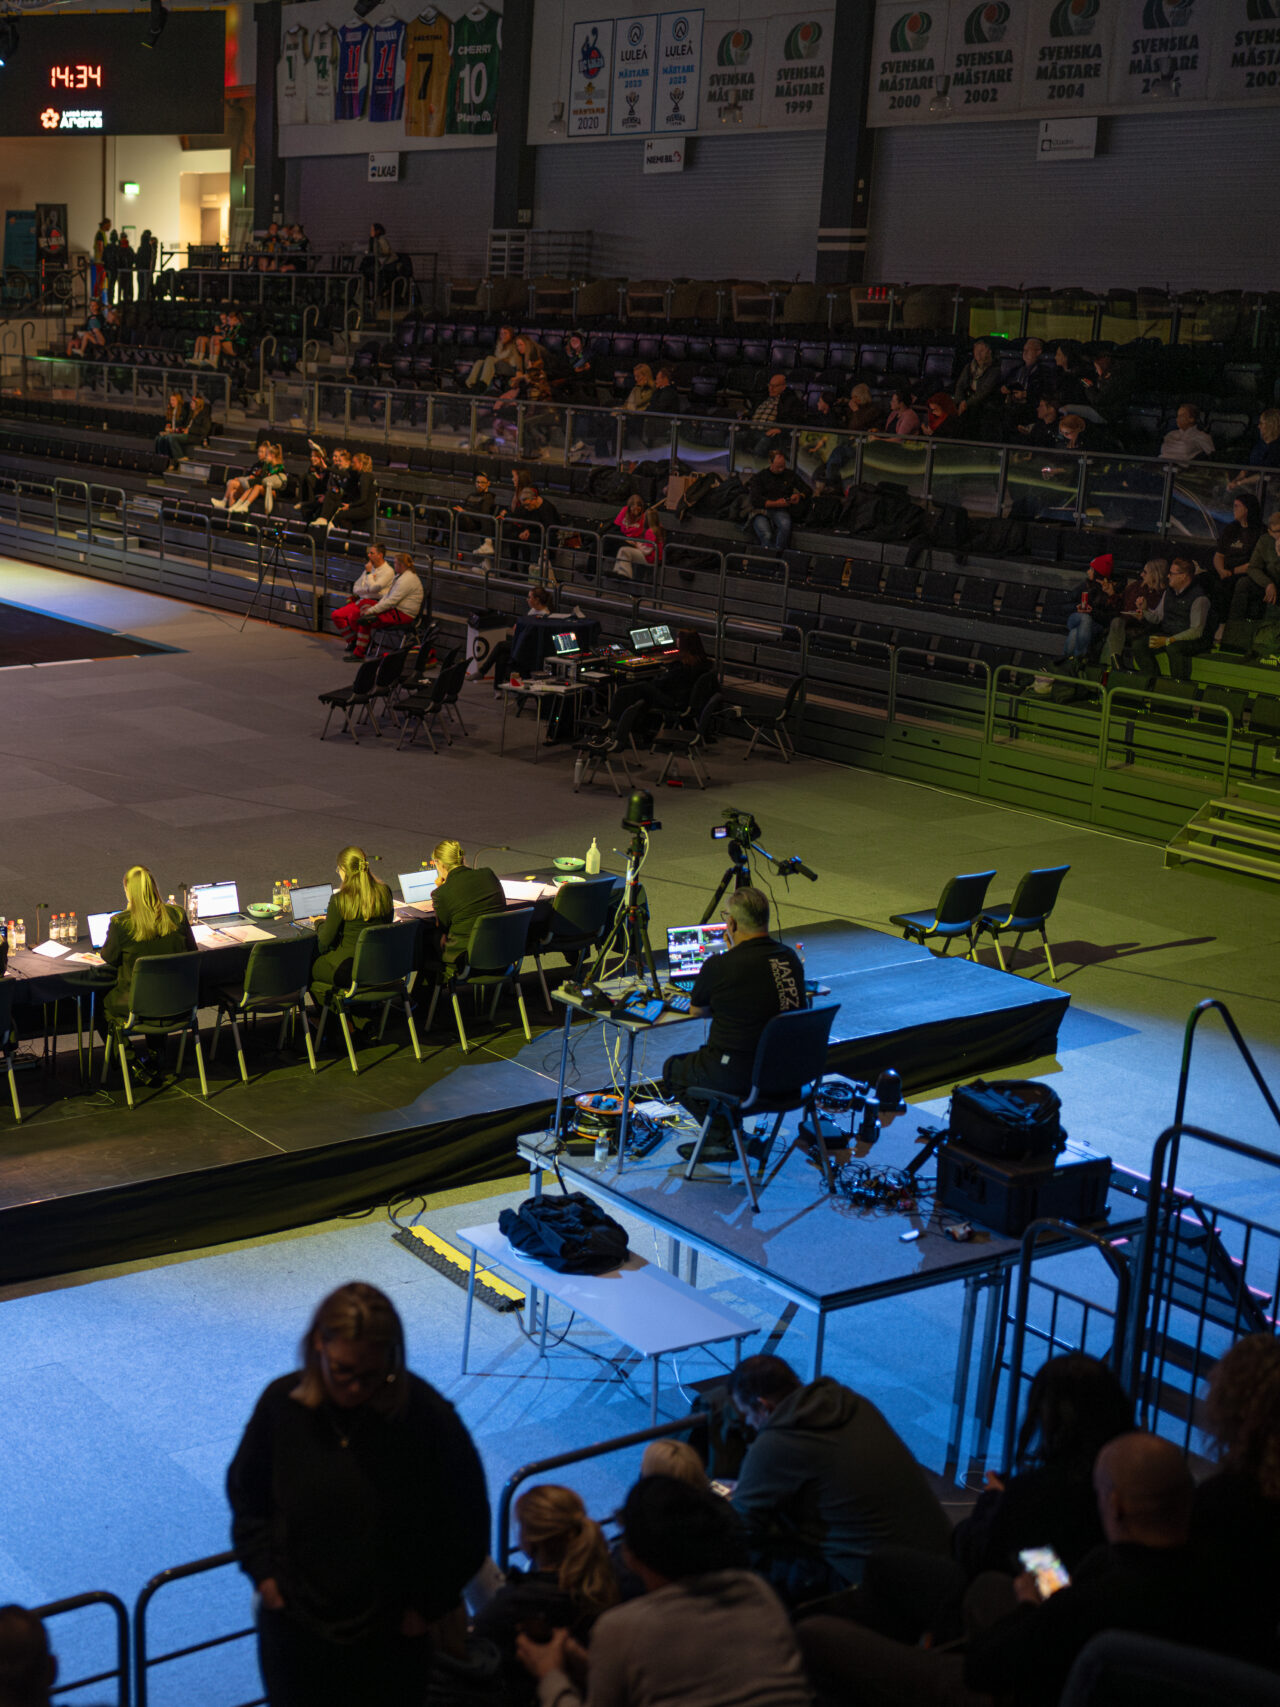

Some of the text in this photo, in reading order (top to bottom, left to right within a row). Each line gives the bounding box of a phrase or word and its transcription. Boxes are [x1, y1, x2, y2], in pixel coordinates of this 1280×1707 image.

[457, 44, 492, 55] CHERRY
[621, 44, 648, 62] LULEÅ
[665, 40, 693, 57] LULEÅ
[1038, 43, 1102, 61] SVENSKA
[1132, 34, 1199, 55] SVENSKA
[344, 44, 361, 79] 11
[376, 43, 397, 79] 14
[880, 58, 935, 75] SVENSKA
[955, 49, 1013, 68] SVENSKA
[1129, 53, 1199, 75] MÄSRE
[51, 65, 102, 88] 14:34
[417, 53, 434, 100] 7
[709, 72, 755, 86] SVENSKA
[777, 65, 825, 80] SVENSKA
[952, 67, 1013, 87] MÄSTARE
[1036, 62, 1102, 80] MÄSTARE
[1245, 70, 1280, 88] 200
[459, 62, 488, 104] 10
[775, 82, 825, 98] MÄSTARE
[878, 75, 934, 92] MÄSTARE
[1048, 83, 1084, 99] 2004
[1141, 76, 1182, 97] 26
[707, 87, 755, 103] MÄSRE
[888, 94, 921, 110] 2000
[964, 88, 998, 104] 2002
[785, 100, 813, 114] 1999
[60, 117, 103, 128] Arena
[577, 116, 599, 130] 2020
[647, 142, 653, 150] H
[377, 165, 396, 177] LKAB
